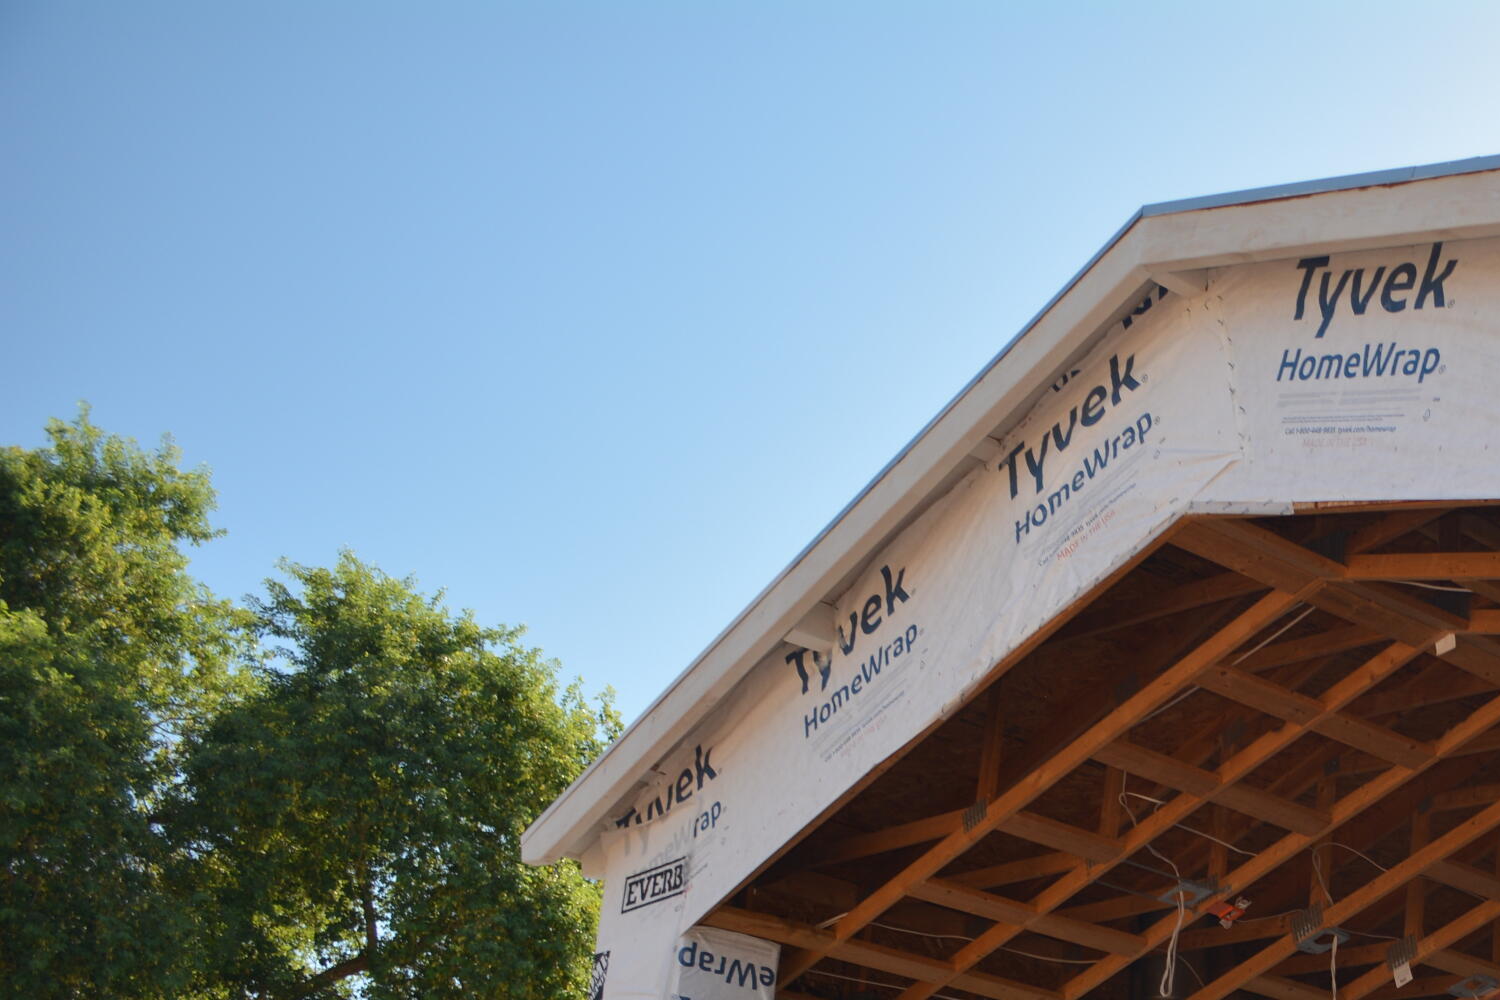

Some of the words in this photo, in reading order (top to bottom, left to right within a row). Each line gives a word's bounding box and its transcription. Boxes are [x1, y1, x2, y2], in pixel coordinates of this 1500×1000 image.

[1294, 242, 1457, 337] Tyvek
[1276, 342, 1440, 383] HomeWrap
[997, 353, 1141, 500] Tyvek
[1015, 411, 1153, 544] HomeWrap
[803, 623, 918, 738] HomeWrap
[626, 864, 683, 906] EVERB
[678, 942, 775, 990] eWrap
